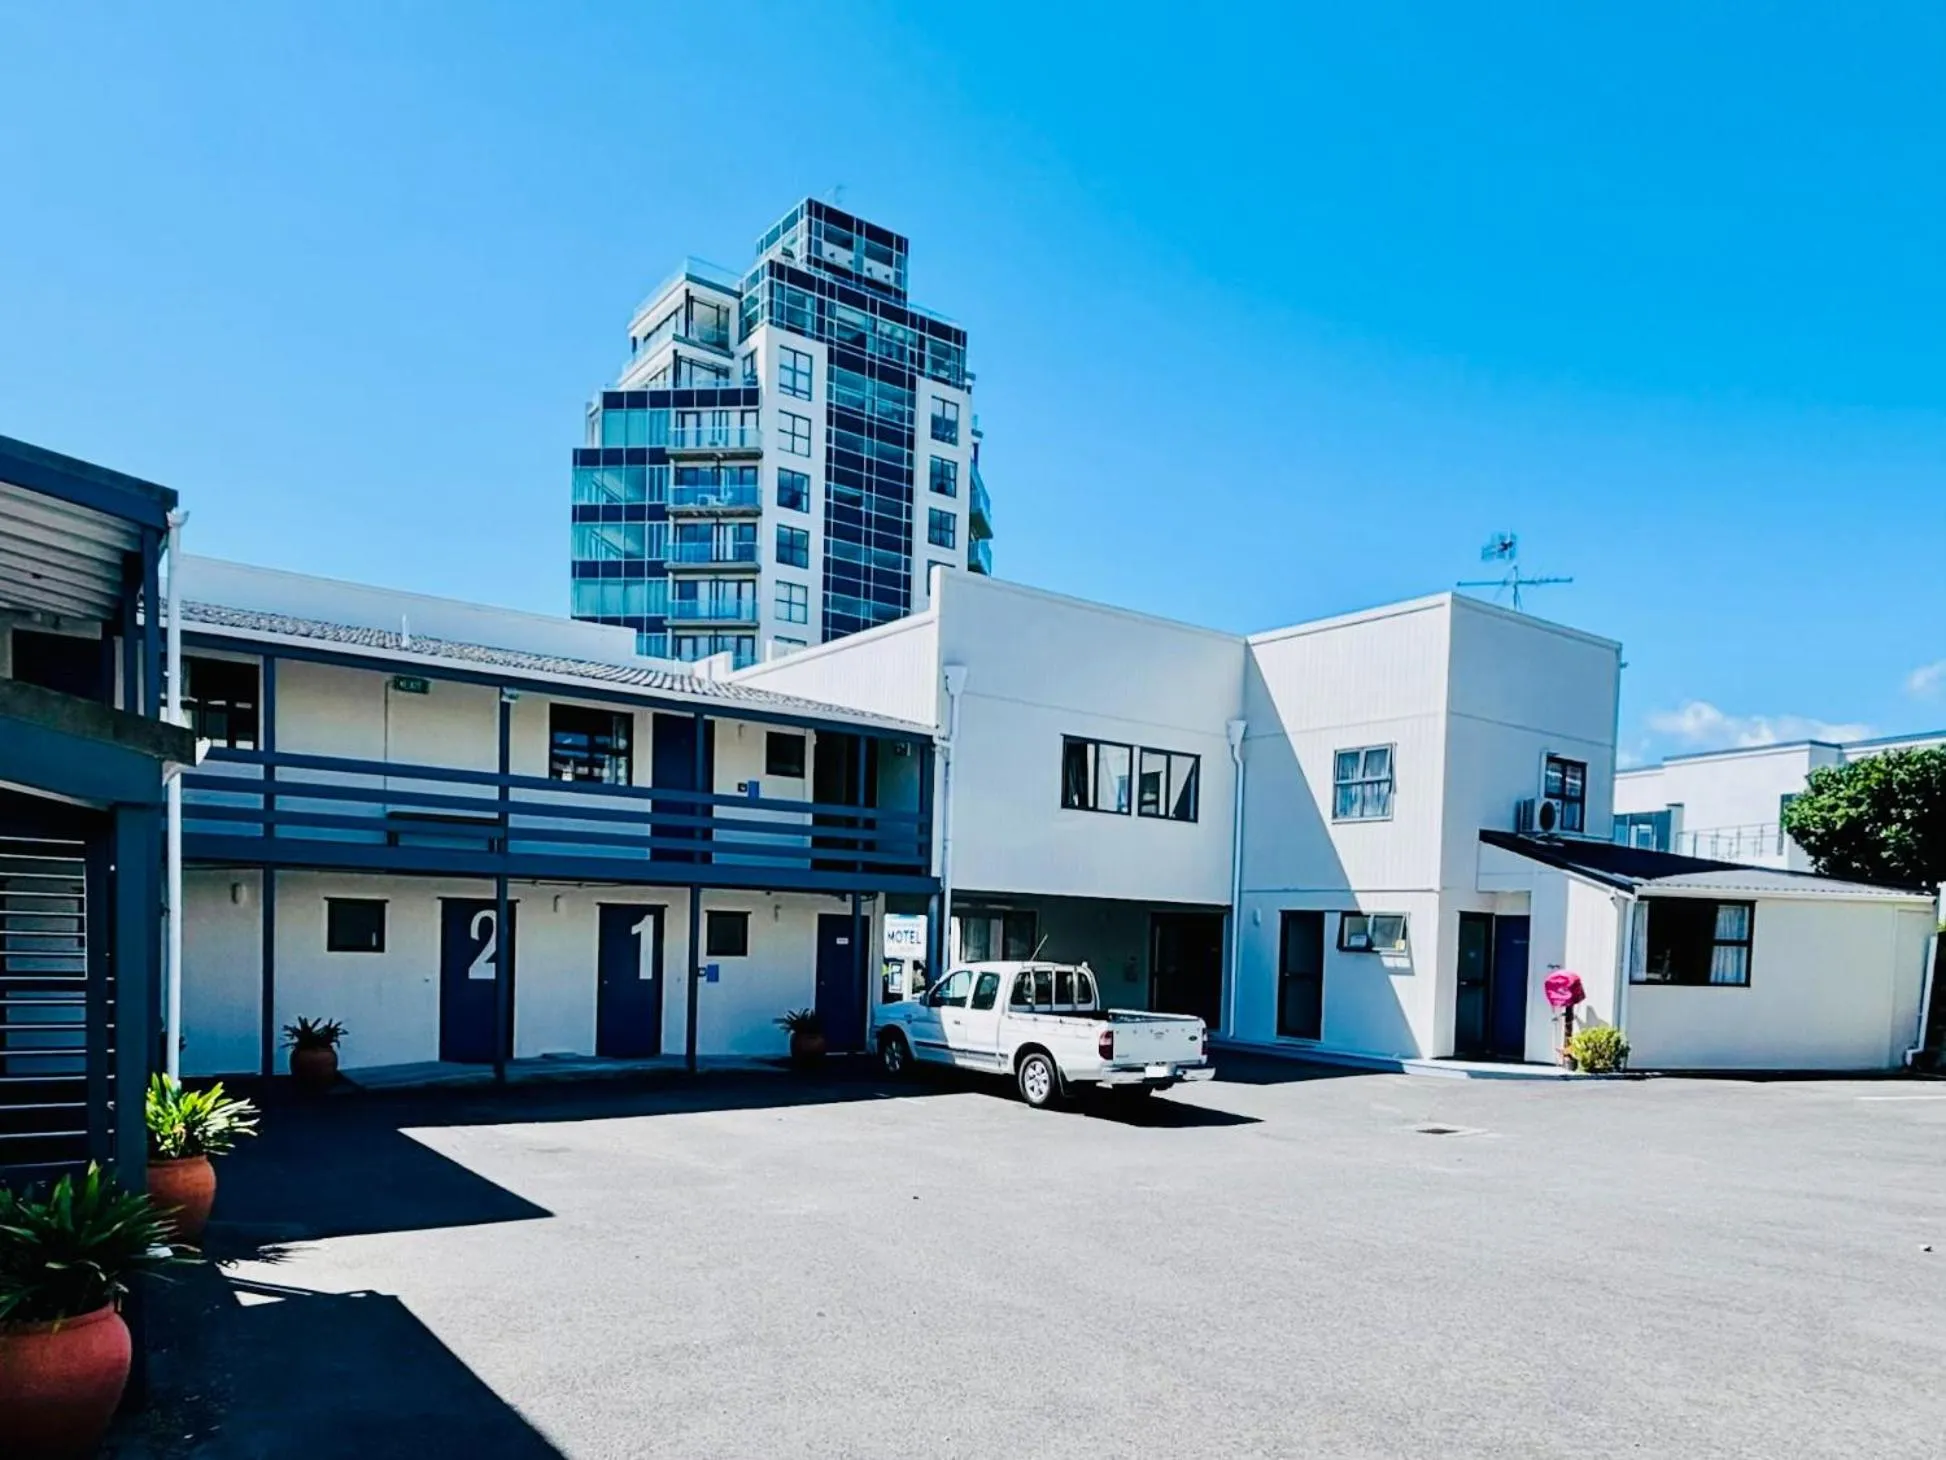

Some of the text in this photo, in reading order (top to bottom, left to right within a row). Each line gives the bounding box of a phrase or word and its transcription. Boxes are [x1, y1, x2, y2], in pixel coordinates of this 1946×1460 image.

[468, 909, 497, 979] 2
[631, 914, 654, 979] 1
[887, 929, 922, 944] MOTEL
